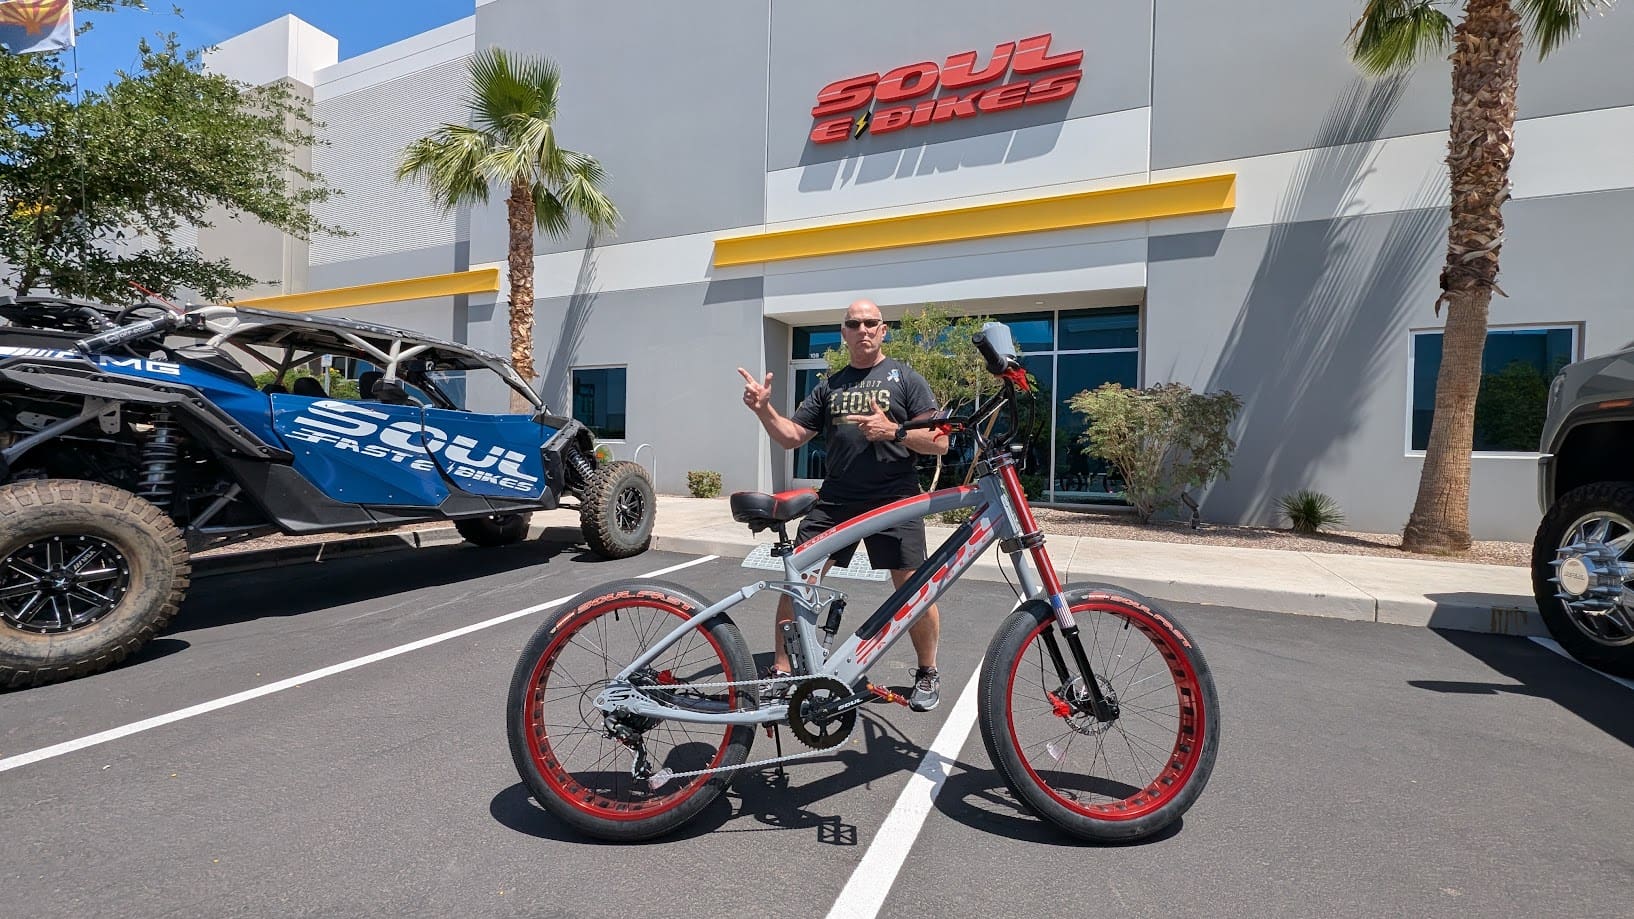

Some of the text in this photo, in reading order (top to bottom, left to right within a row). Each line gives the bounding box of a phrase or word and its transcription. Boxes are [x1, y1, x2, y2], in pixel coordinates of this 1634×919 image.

[811, 33, 1084, 118] SOUL
[810, 69, 1083, 144] E BIKES
[841, 380, 882, 389] DETROIT
[830, 389, 891, 415] LIONS
[294, 400, 538, 483] SOUL
[454, 466, 535, 492] BIKES
[577, 590, 695, 614] SOUL FAST
[837, 698, 863, 711] SOUL
